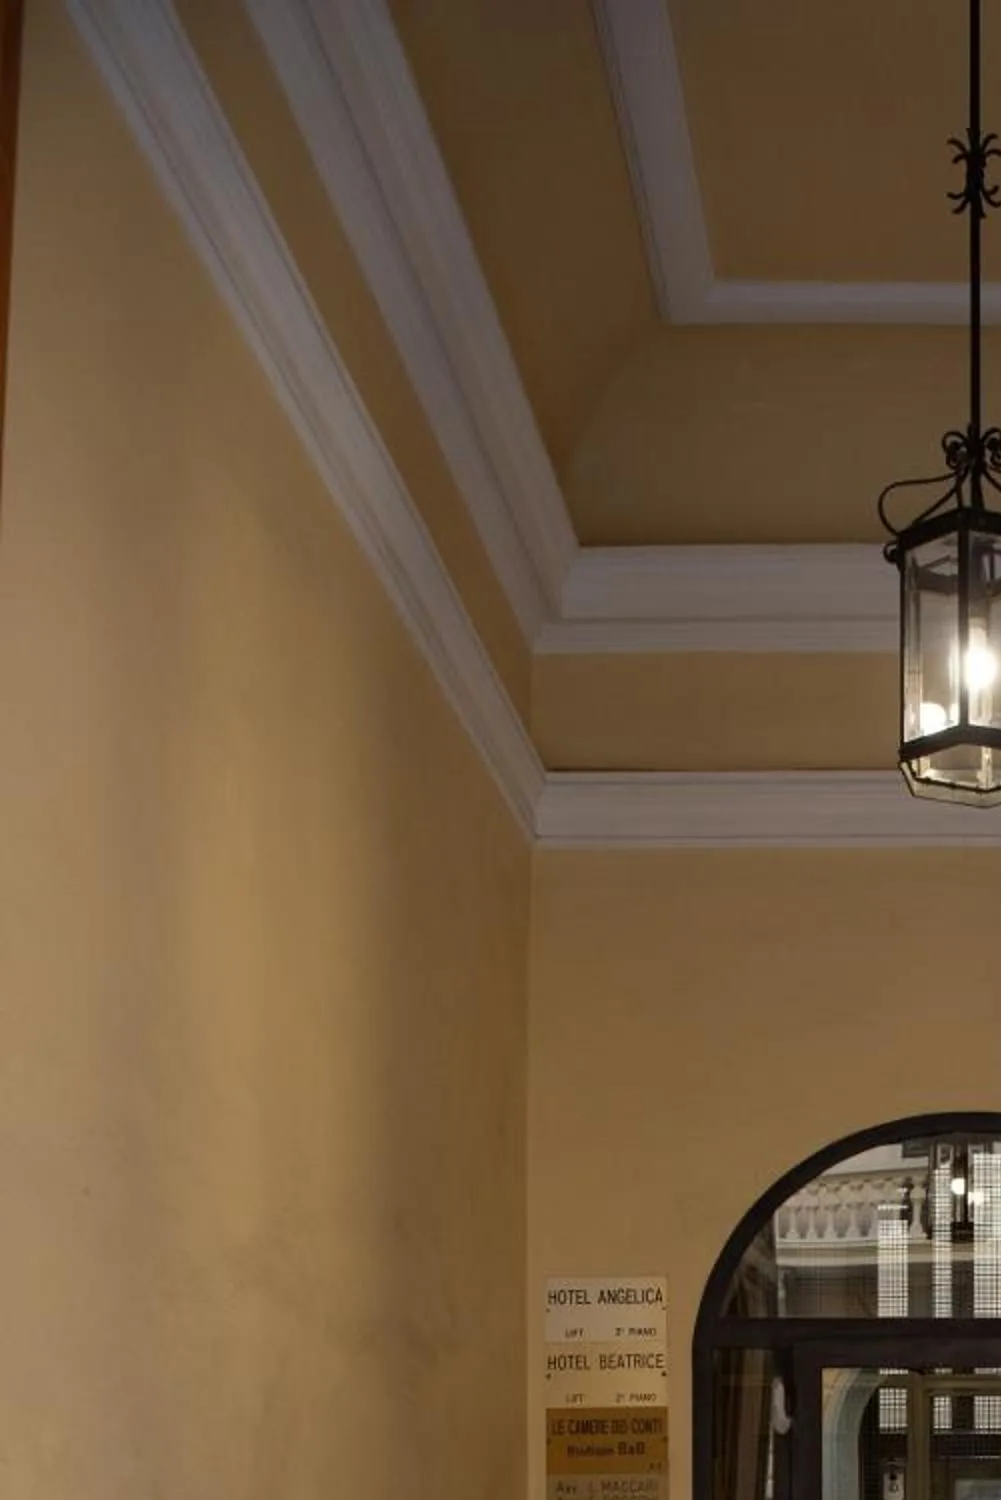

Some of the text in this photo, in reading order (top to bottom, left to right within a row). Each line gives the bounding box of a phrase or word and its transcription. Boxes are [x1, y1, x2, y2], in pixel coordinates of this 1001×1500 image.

[547, 1287, 663, 1306] HOTEL ANGELICA
[547, 1353, 665, 1371] HOTEL BEATRICE
[567, 1418, 609, 1435] CAMERE
[631, 1417, 663, 1434] CONTI
